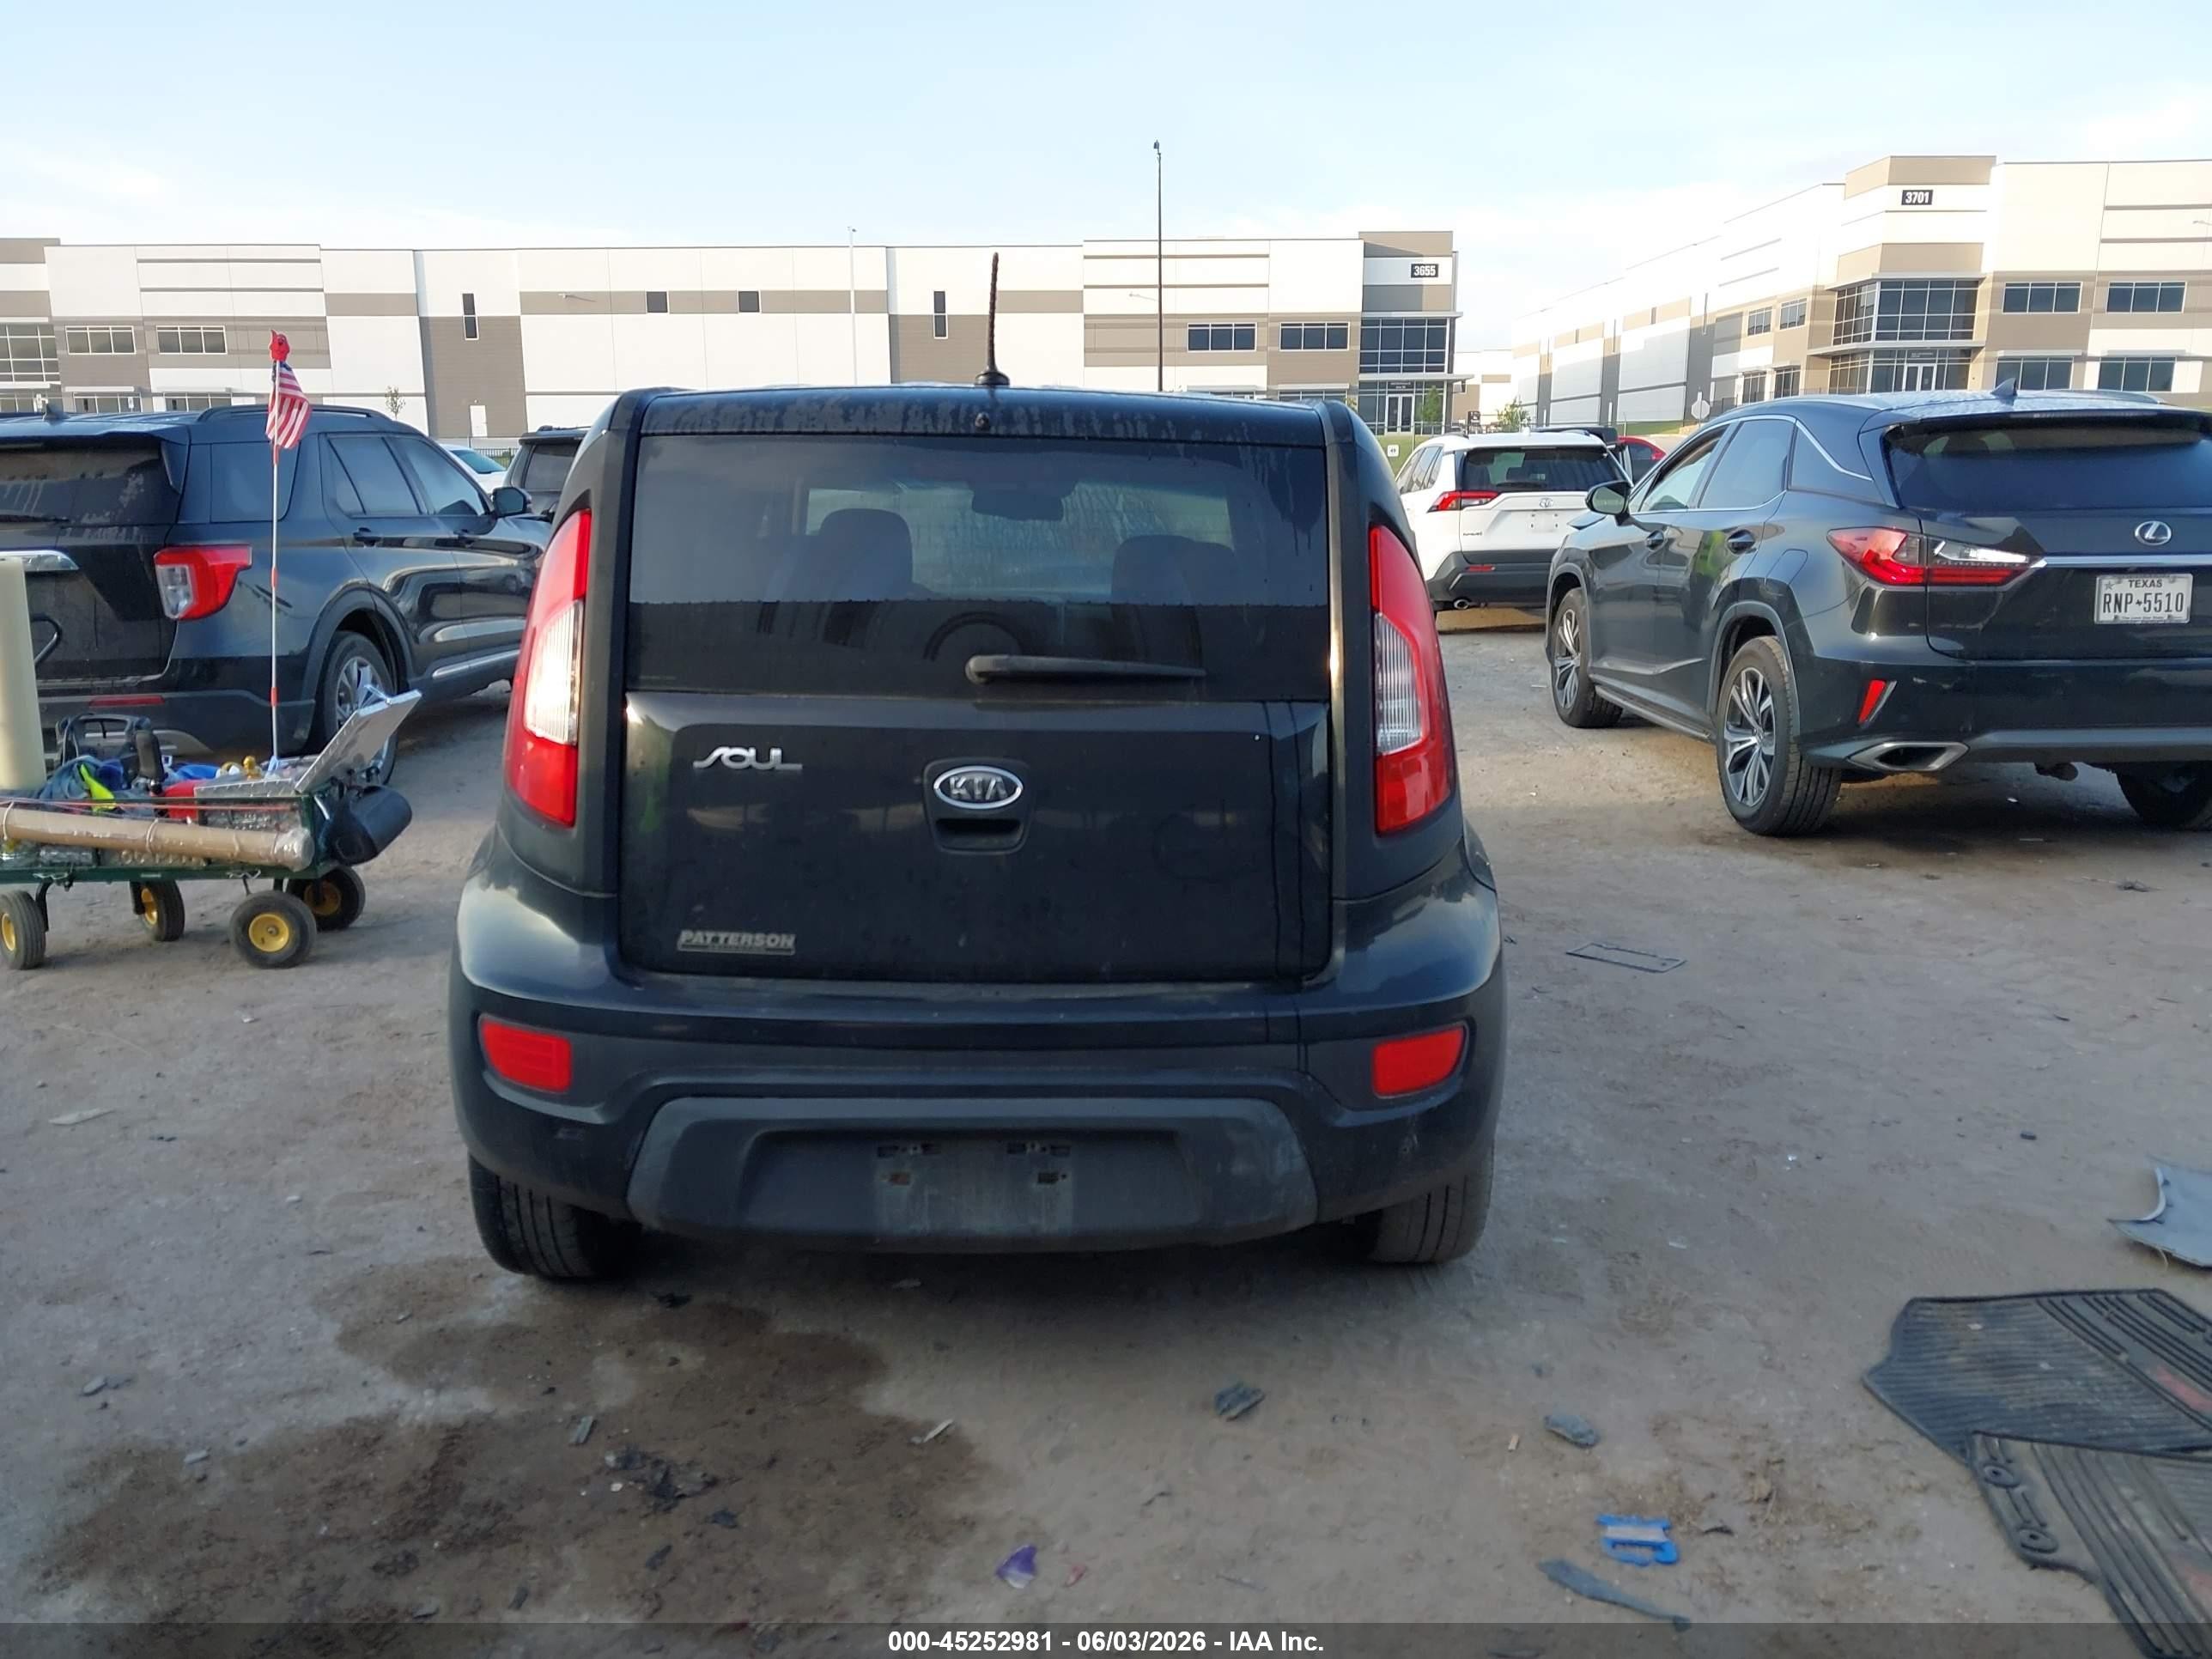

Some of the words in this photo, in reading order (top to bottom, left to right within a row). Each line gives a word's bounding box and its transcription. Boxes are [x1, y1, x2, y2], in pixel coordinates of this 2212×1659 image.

[1905, 191, 1929, 204] 3701
[1413, 265, 1437, 276] 3655
[2128, 579, 2163, 588] TEXAS
[692, 745, 803, 770] SOUL
[949, 775, 1009, 800] KIA
[680, 929, 796, 949] PATTERSON
